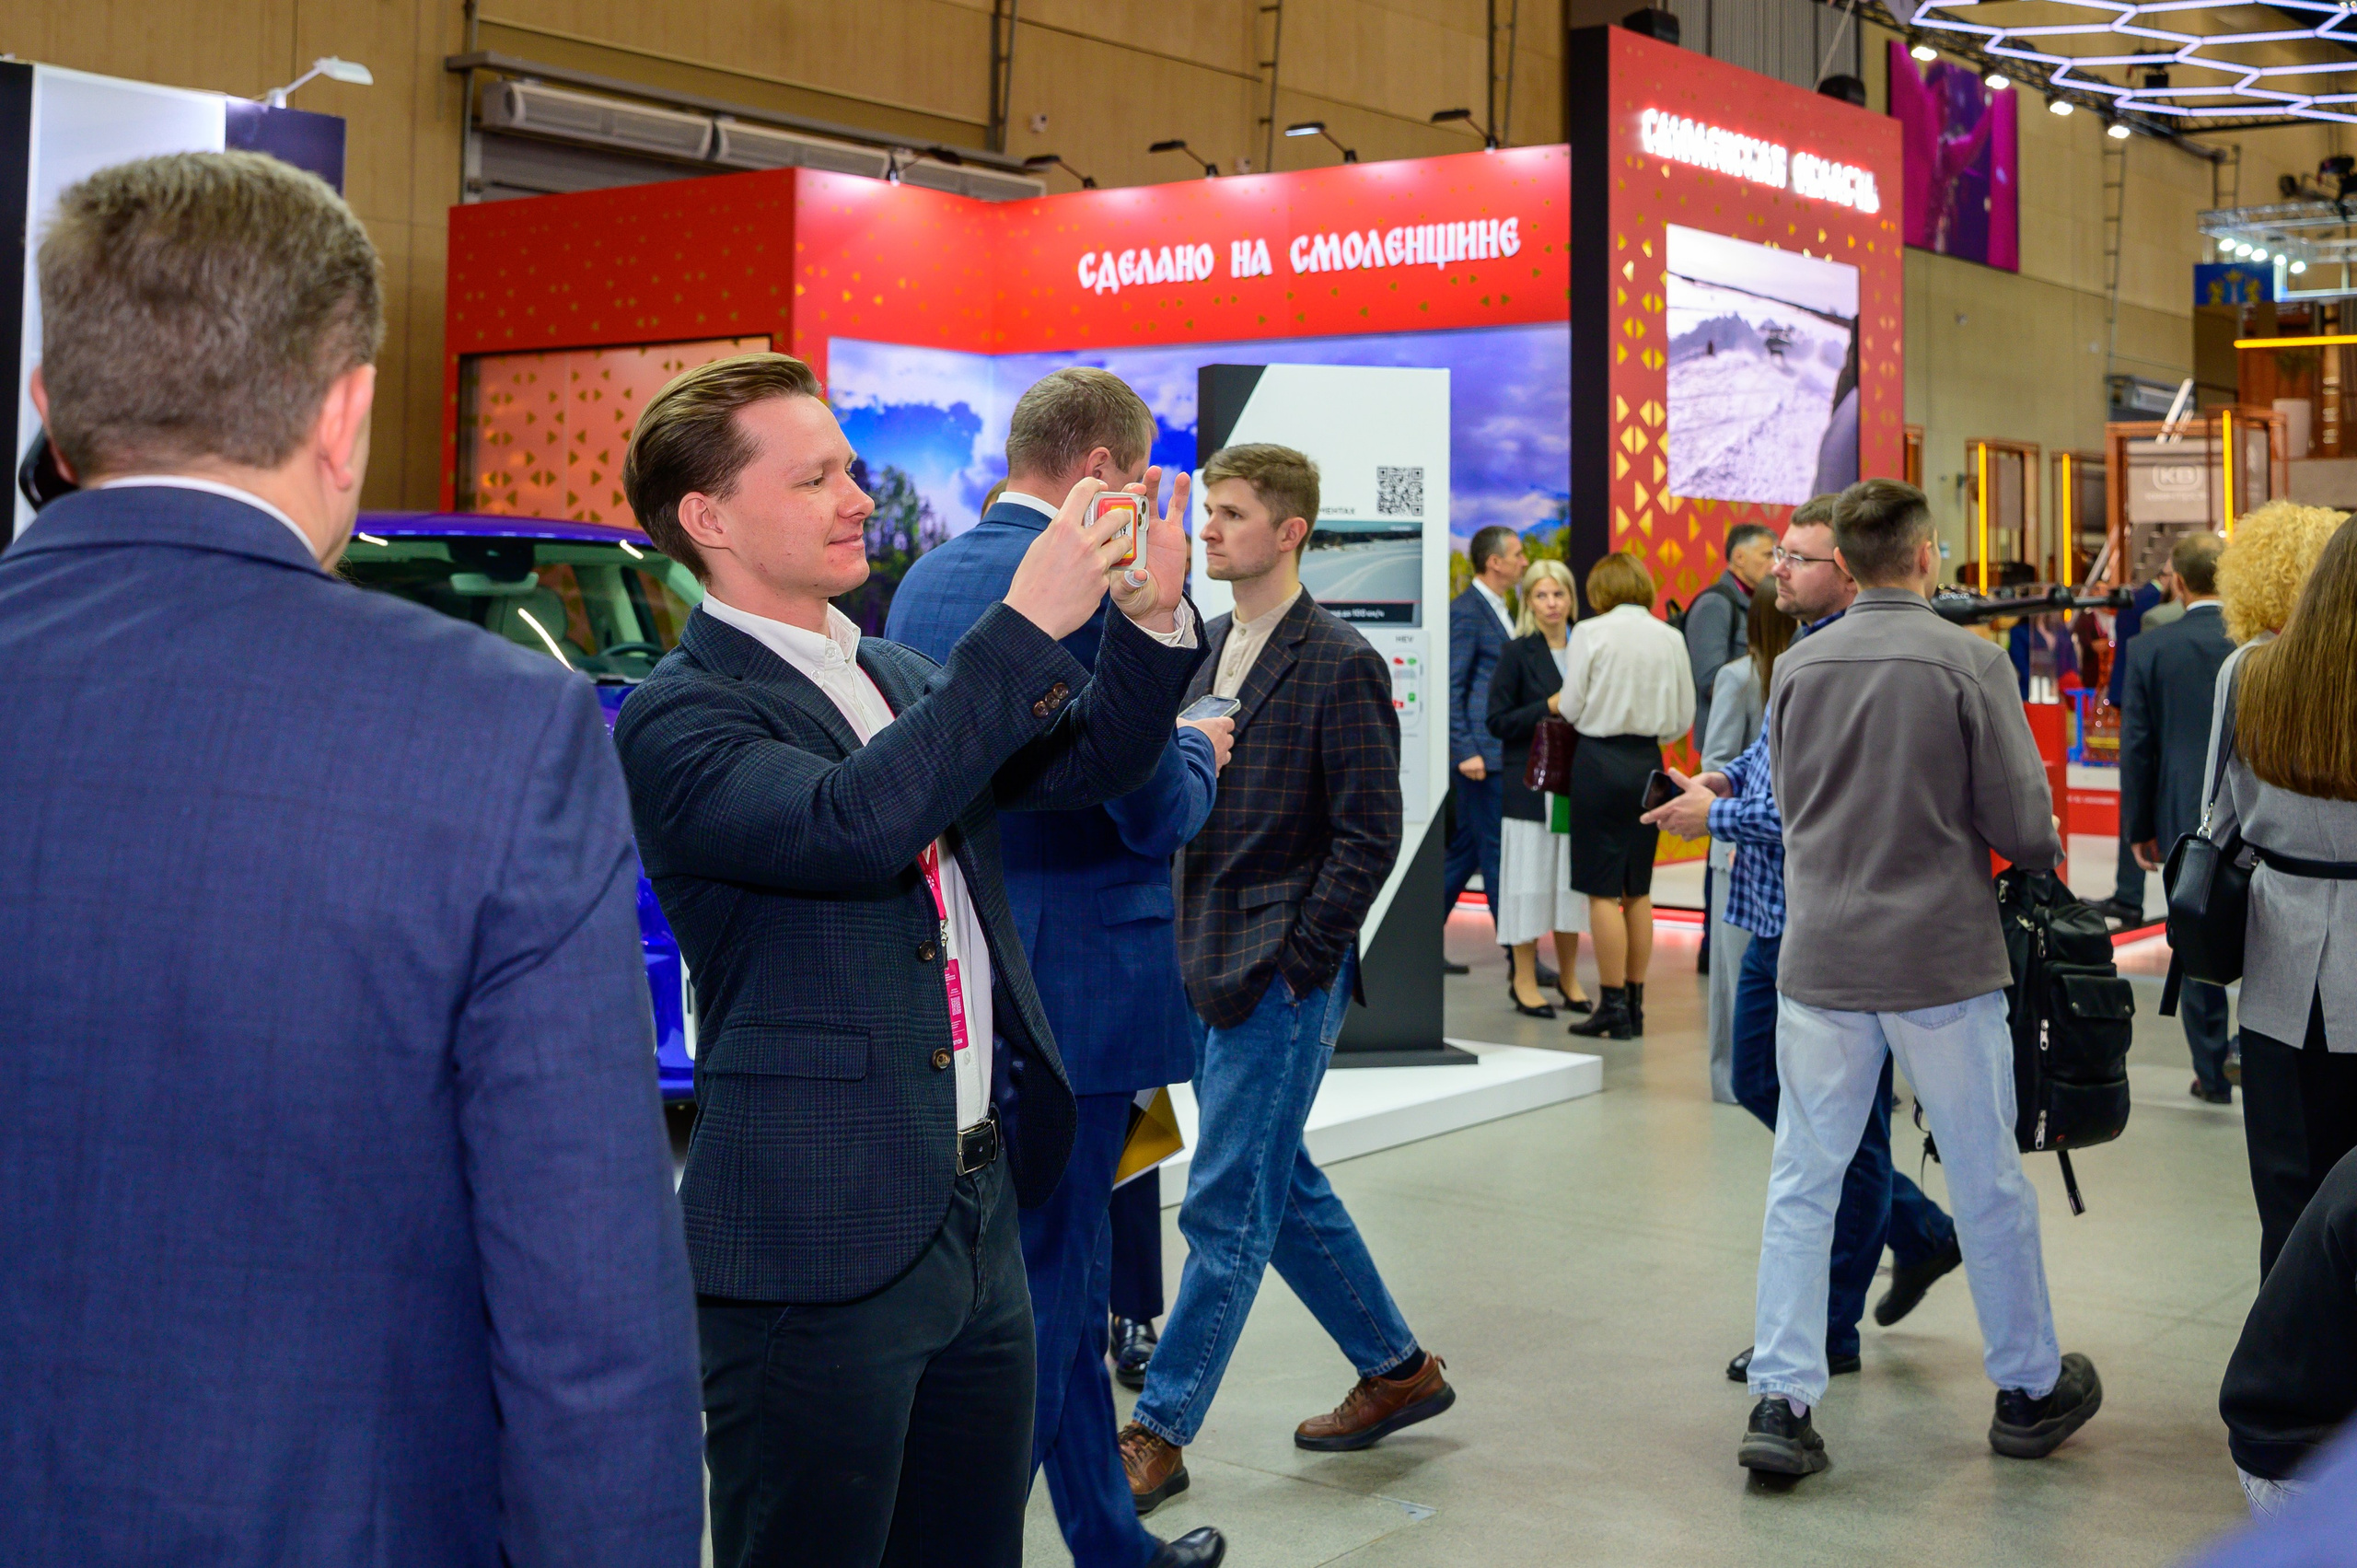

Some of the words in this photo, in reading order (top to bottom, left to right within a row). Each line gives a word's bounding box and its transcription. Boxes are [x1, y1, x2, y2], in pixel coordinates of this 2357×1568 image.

[1077, 242, 1214, 295] СДЕЛАНО
[1230, 238, 1272, 278] НА
[1289, 216, 1521, 274] СМОЛЕНЩИНЕ
